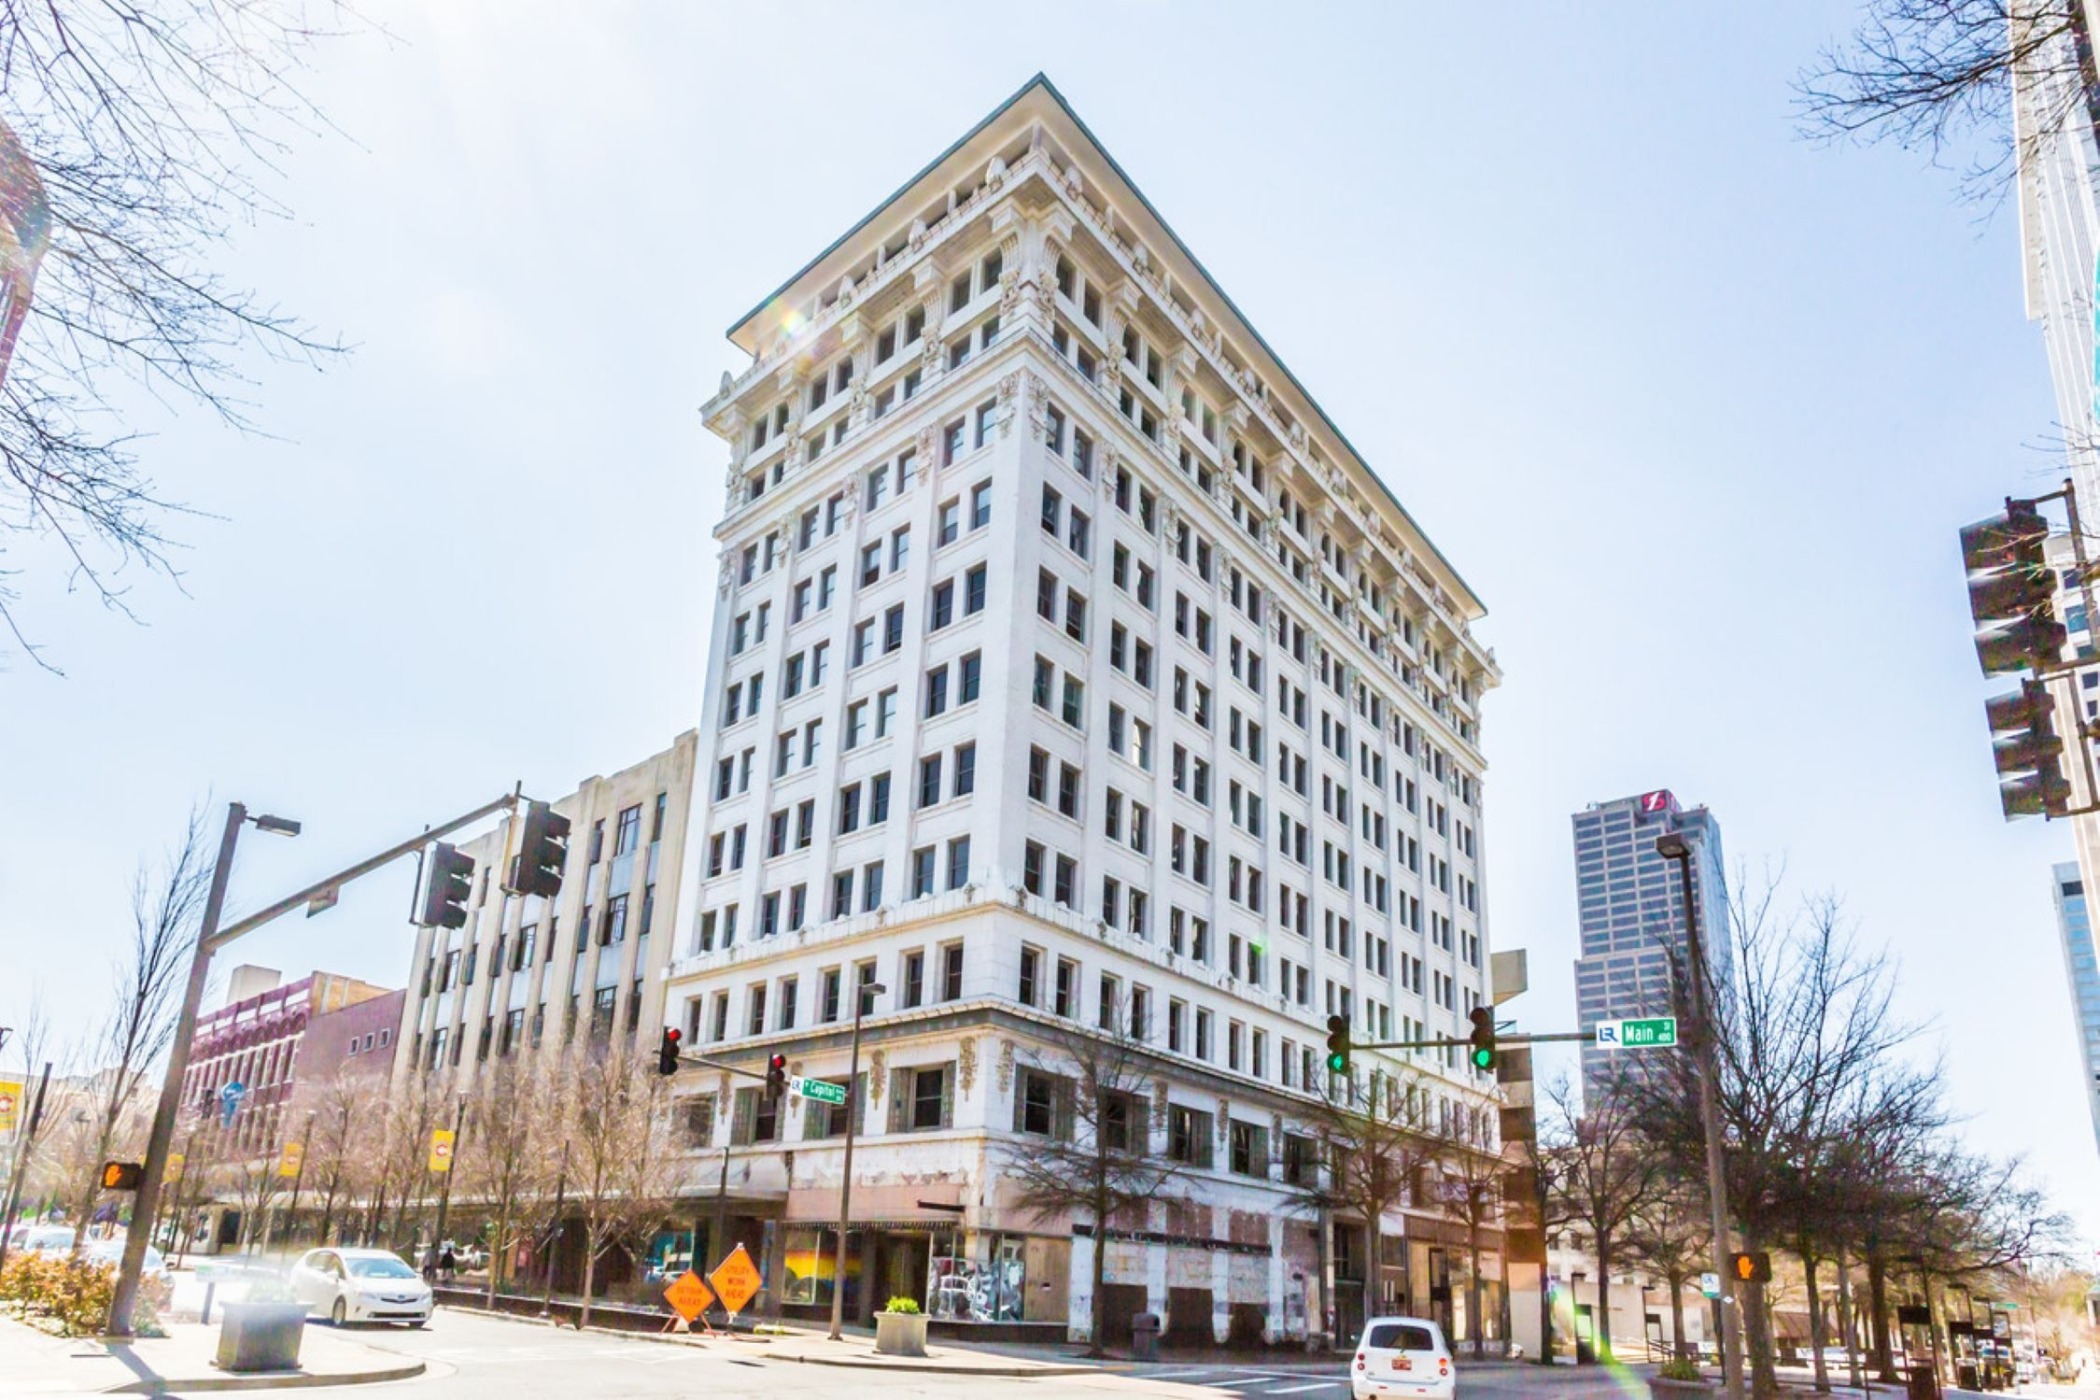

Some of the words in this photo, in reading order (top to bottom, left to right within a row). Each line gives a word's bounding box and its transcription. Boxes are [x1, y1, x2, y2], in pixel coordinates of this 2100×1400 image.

[1624, 1025, 1654, 1042] Main
[810, 1081, 835, 1098] Capitol
[678, 1296, 701, 1306] AHEAD
[725, 1289, 745, 1300] AHEAD
